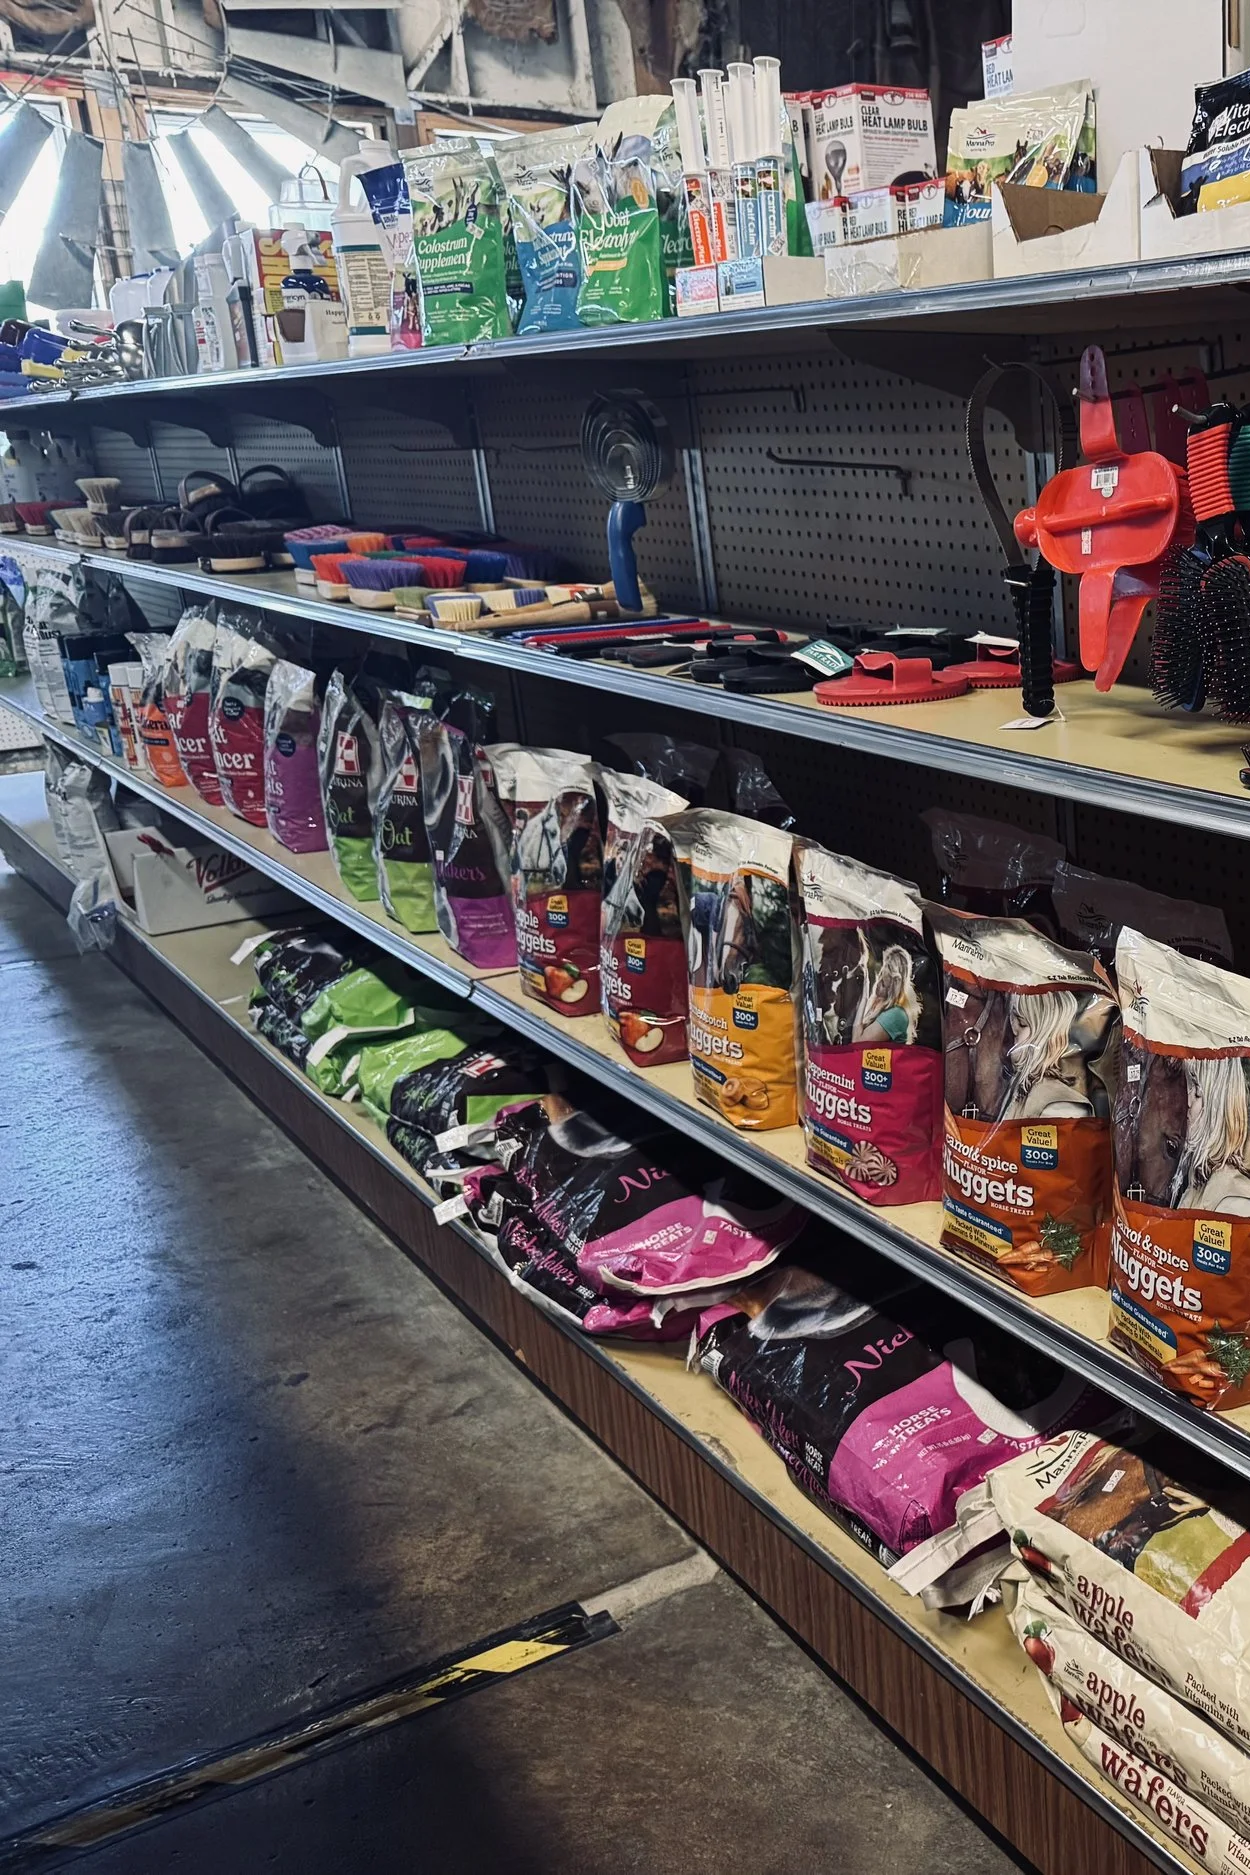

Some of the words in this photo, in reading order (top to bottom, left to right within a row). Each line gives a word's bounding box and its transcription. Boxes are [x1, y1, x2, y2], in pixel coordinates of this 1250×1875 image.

[987, 72, 1001, 88] HEAT
[861, 106, 879, 115] CLEAR
[862, 117, 881, 128] HEAT
[883, 118, 905, 129] LAMP
[907, 120, 928, 131] BULB
[418, 236, 467, 254] Colostrum
[382, 819, 413, 850] Oat
[735, 1011, 755, 1021] 300+
[866, 1052, 885, 1062] Great
[864, 1071, 888, 1083] 300+
[1027, 1135, 1052, 1146] Value!
[1028, 1128, 1051, 1138] Great
[1025, 1149, 1054, 1160] 300+
[963, 1161, 987, 1175] FLAVOR
[981, 1155, 1018, 1174] spice
[943, 1142, 1034, 1208] Nuggets
[1010, 1207, 1034, 1216] TREATS
[718, 1220, 753, 1239] TASTE
[968, 1212, 1003, 1234] Guaranteed
[1200, 1223, 1224, 1238] Great
[1116, 1215, 1142, 1247] carrot
[1142, 1236, 1152, 1253] &
[1153, 1245, 1189, 1272] spice
[1198, 1233, 1225, 1248] Value!
[1133, 1249, 1156, 1268] FLAVOR
[1196, 1246, 1226, 1264] 300+
[1112, 1227, 1202, 1312] Nuggets
[1133, 1308, 1169, 1338] Guaranteed
[888, 1404, 939, 1437] HORSE
[898, 1407, 952, 1443] TREATS
[1003, 1437, 1042, 1453] TASTE
[1077, 1574, 1134, 1632] apple
[1086, 1671, 1145, 1731] apple
[1184, 1685, 1225, 1721] Vitamins
[1185, 1672, 1217, 1700] Packed
[1219, 1699, 1240, 1722] with
[1200, 1770, 1232, 1798] Packed
[1100, 1742, 1209, 1857] wafers
[1166, 1786, 1186, 1806] FLAVOR
